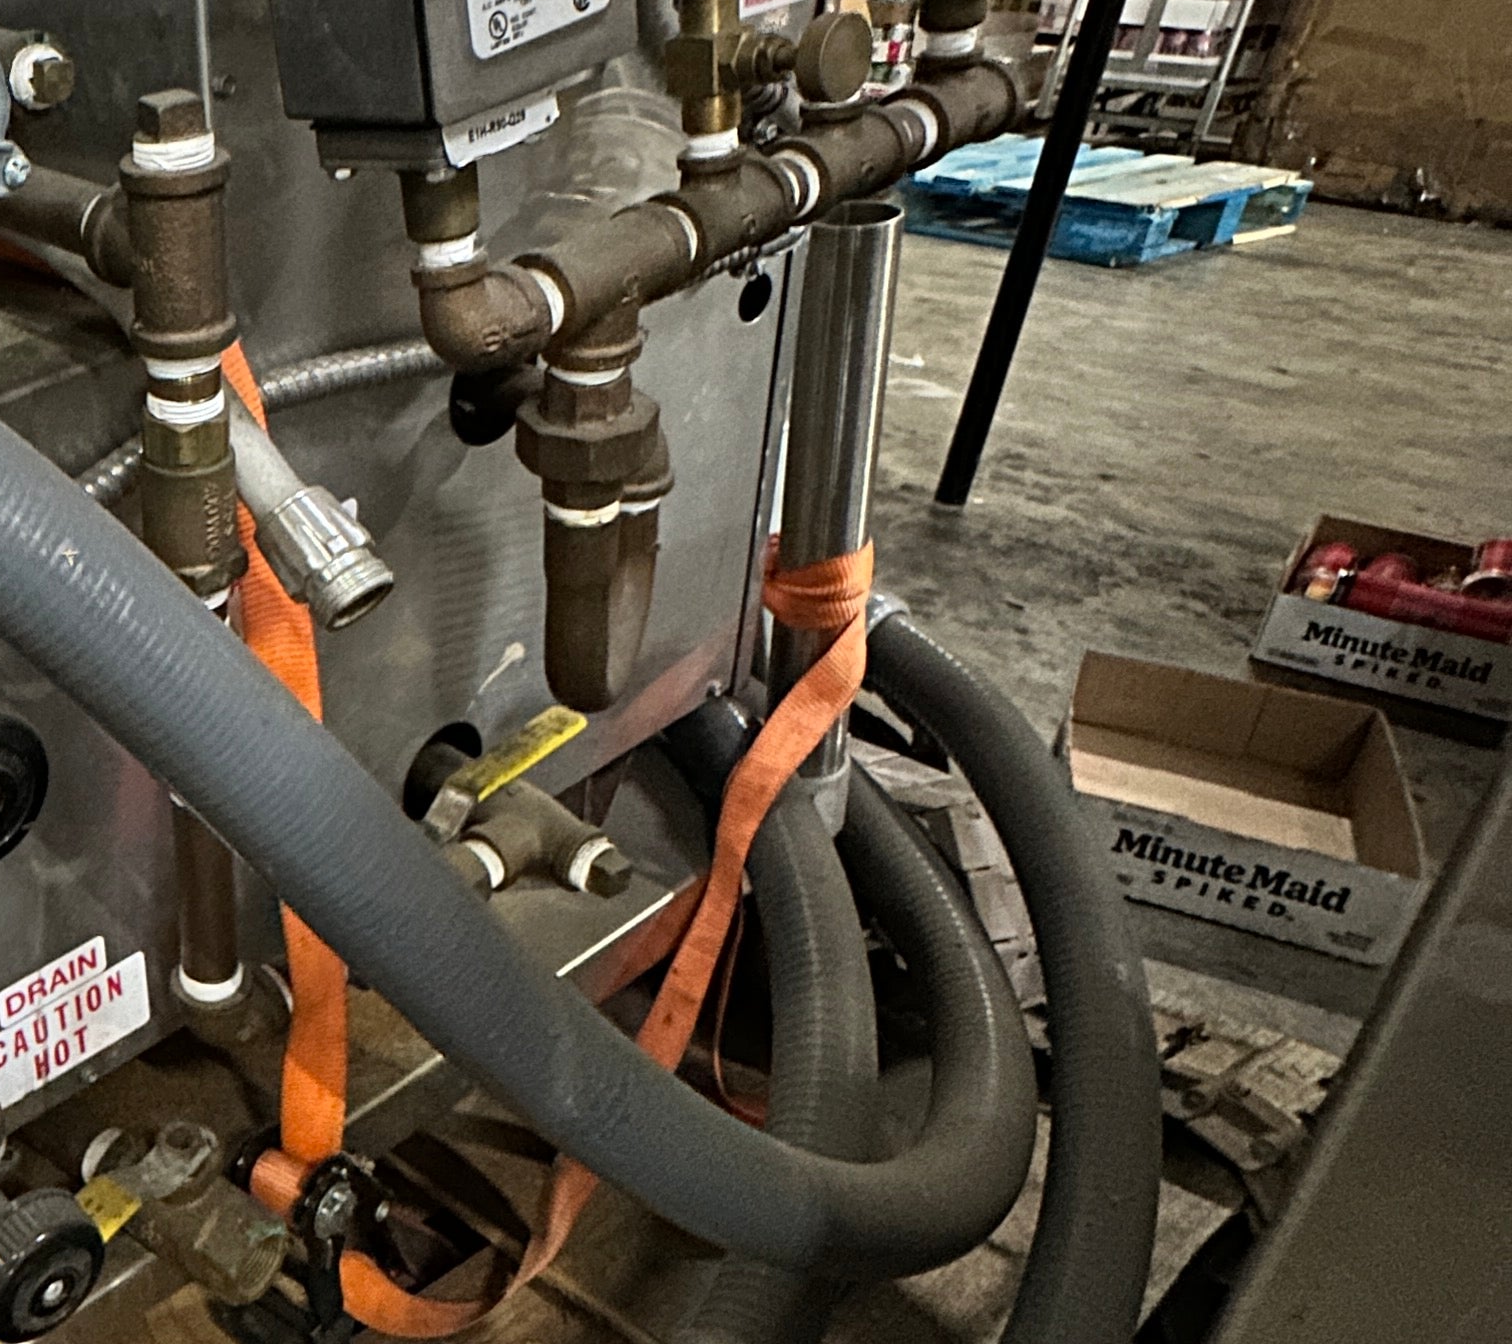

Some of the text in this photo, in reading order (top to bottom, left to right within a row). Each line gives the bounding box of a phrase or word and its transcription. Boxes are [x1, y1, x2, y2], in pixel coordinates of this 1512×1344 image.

[1301, 620, 1410, 664] Minute
[1408, 647, 1494, 684] Maid
[1111, 828, 1351, 914] Minute Maid
[5, 947, 98, 1018] DRAIN
[34, 1025, 88, 1081] HOT
